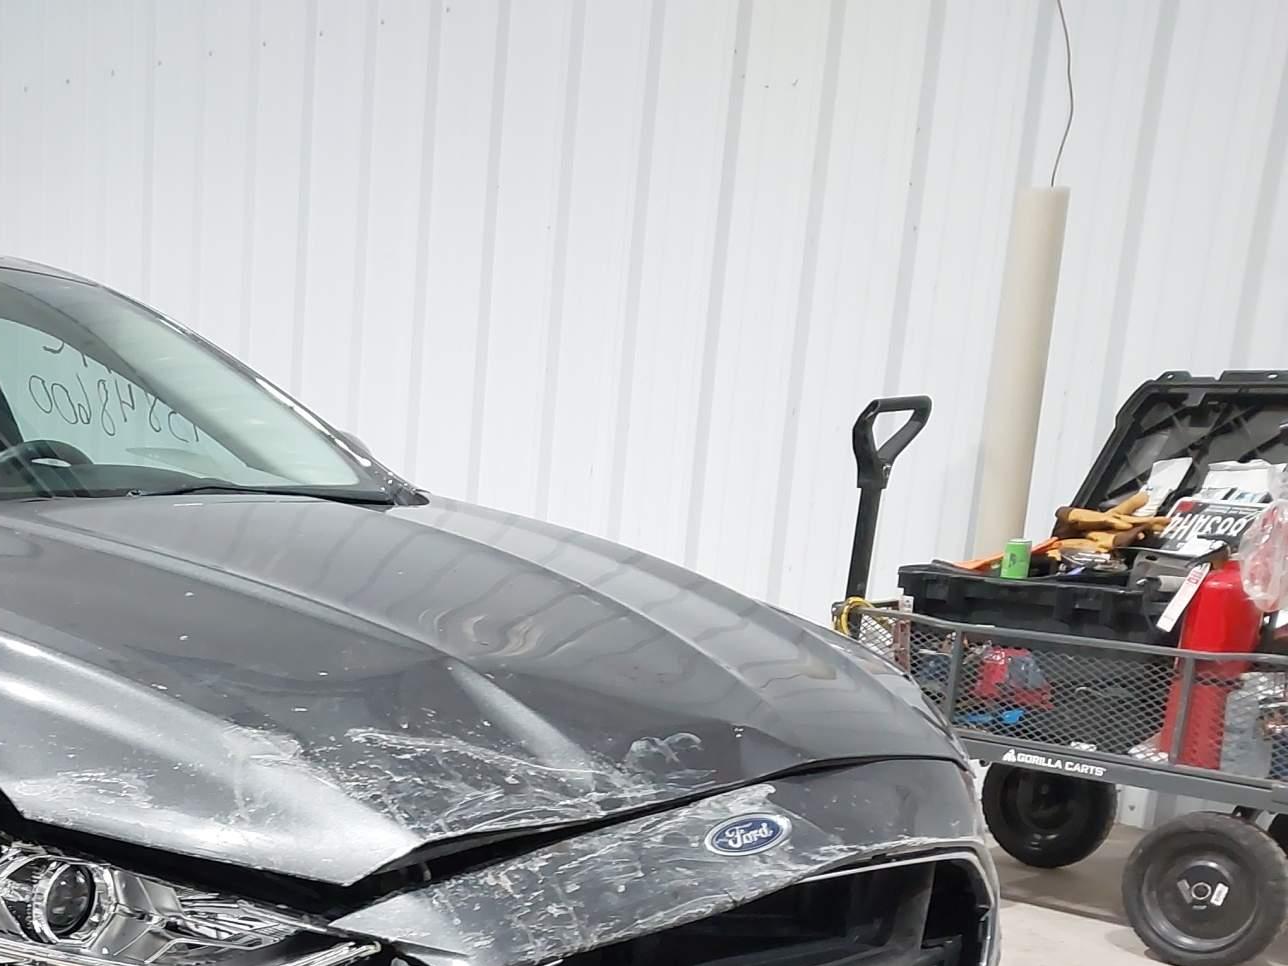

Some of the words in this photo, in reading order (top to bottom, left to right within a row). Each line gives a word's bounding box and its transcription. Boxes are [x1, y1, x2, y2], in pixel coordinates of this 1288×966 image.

[1016, 752, 1063, 769] GORILLA
[1064, 761, 1105, 777] CARTS
[716, 822, 774, 848] Ford
